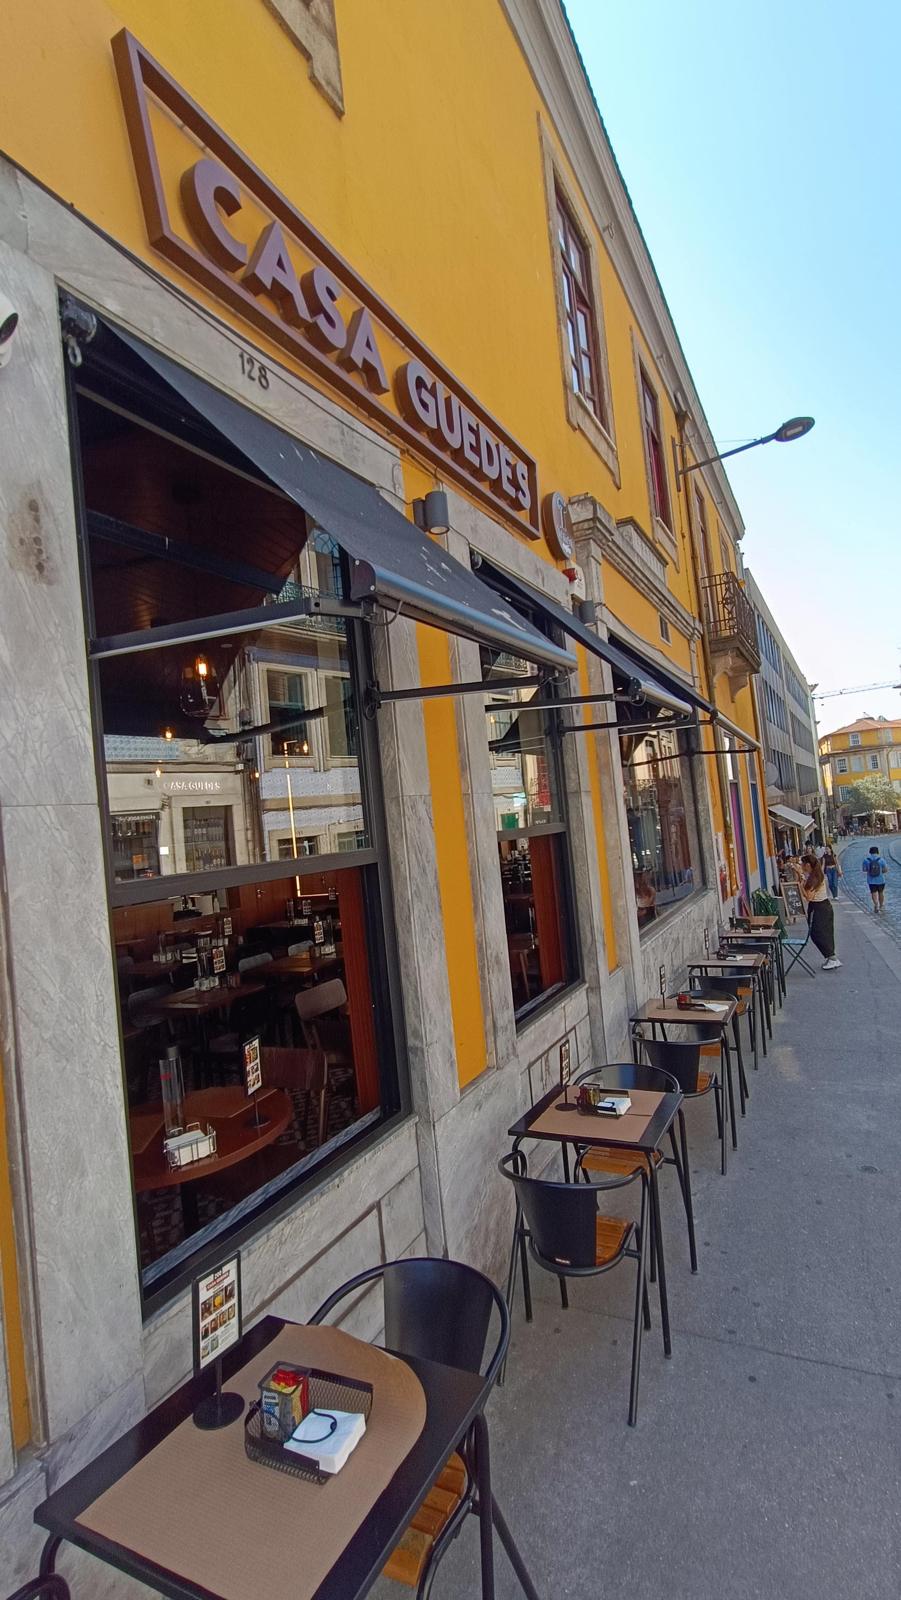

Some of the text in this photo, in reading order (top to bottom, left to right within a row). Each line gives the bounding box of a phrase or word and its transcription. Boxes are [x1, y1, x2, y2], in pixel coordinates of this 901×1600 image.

[181, 159, 532, 511] CASA GUEDES
[239, 352, 269, 390] 128
